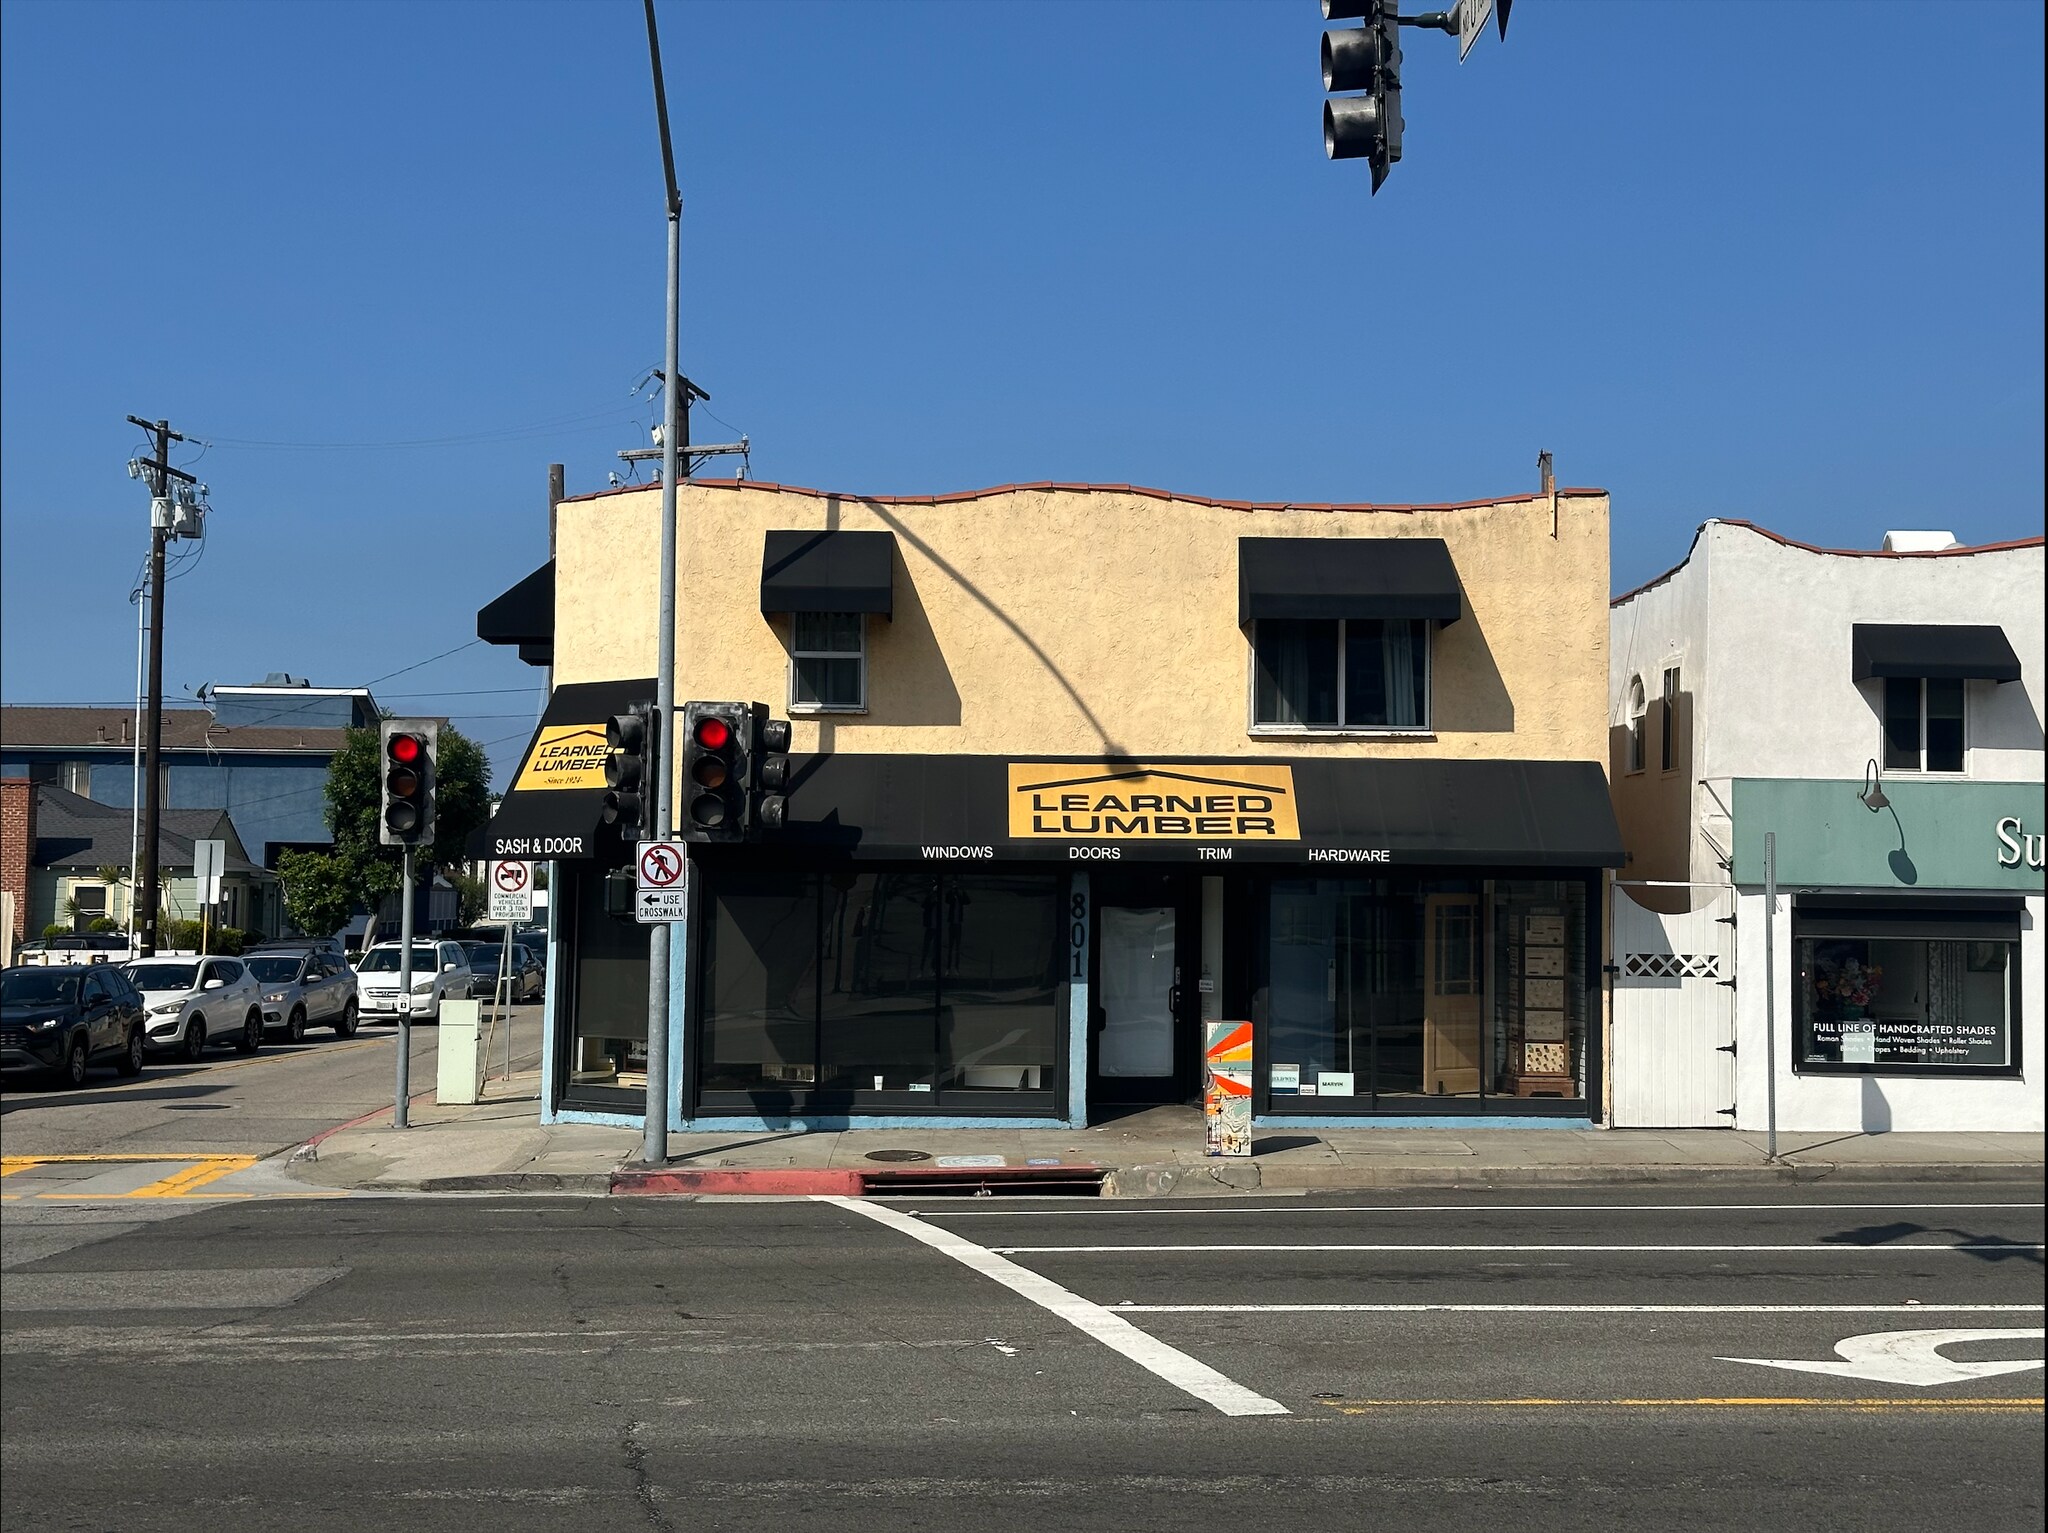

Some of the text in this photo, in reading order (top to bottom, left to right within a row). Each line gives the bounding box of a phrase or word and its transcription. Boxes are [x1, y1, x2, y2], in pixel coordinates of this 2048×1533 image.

[539, 745, 614, 758] LEARNED
[1032, 794, 1274, 813] LEARNED
[1032, 815, 1277, 835] LUMBER
[495, 837, 583, 854] SASH & DOOR
[921, 846, 1391, 862] WINDOWS DOORS TRIM HARDWARE
[663, 895, 680, 904] USE
[640, 908, 684, 917] CROSSWALK
[1071, 893, 1086, 977] 801
[1813, 1023, 1996, 1035] FULL LINE OF HANDCRAFTED SHADES
[1817, 1034, 1840, 1042] Roman
[1892, 1035, 1915, 1043] Woven
[1916, 1036, 1940, 1044] Shades
[1948, 1037, 1967, 1045] Roller
[1899, 1045, 1926, 1055] Bedding
[1935, 1047, 1970, 1056] Upholstery
